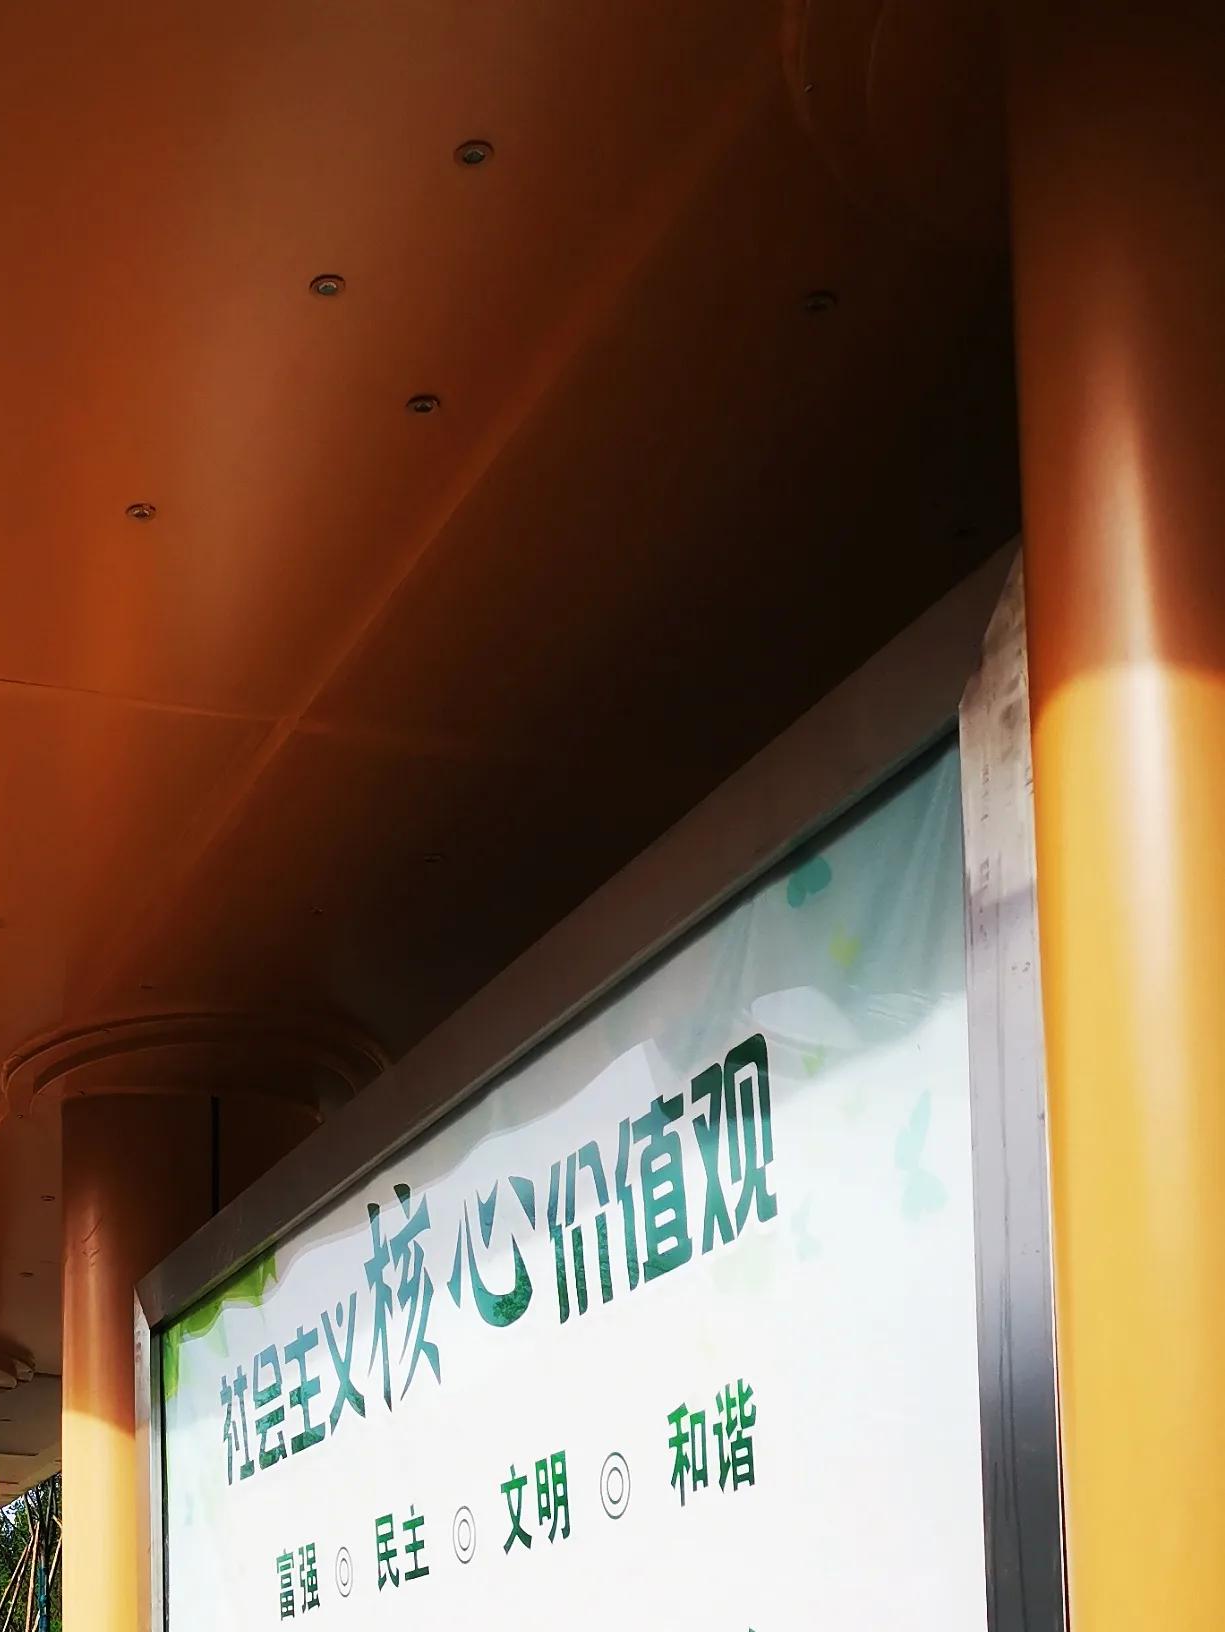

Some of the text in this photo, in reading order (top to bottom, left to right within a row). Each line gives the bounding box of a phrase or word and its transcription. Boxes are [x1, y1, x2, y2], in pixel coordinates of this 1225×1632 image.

[219, 1033, 778, 1485] 社会主义核心价值观
[277, 1379, 756, 1620] 富强 民主 文明 和谐
